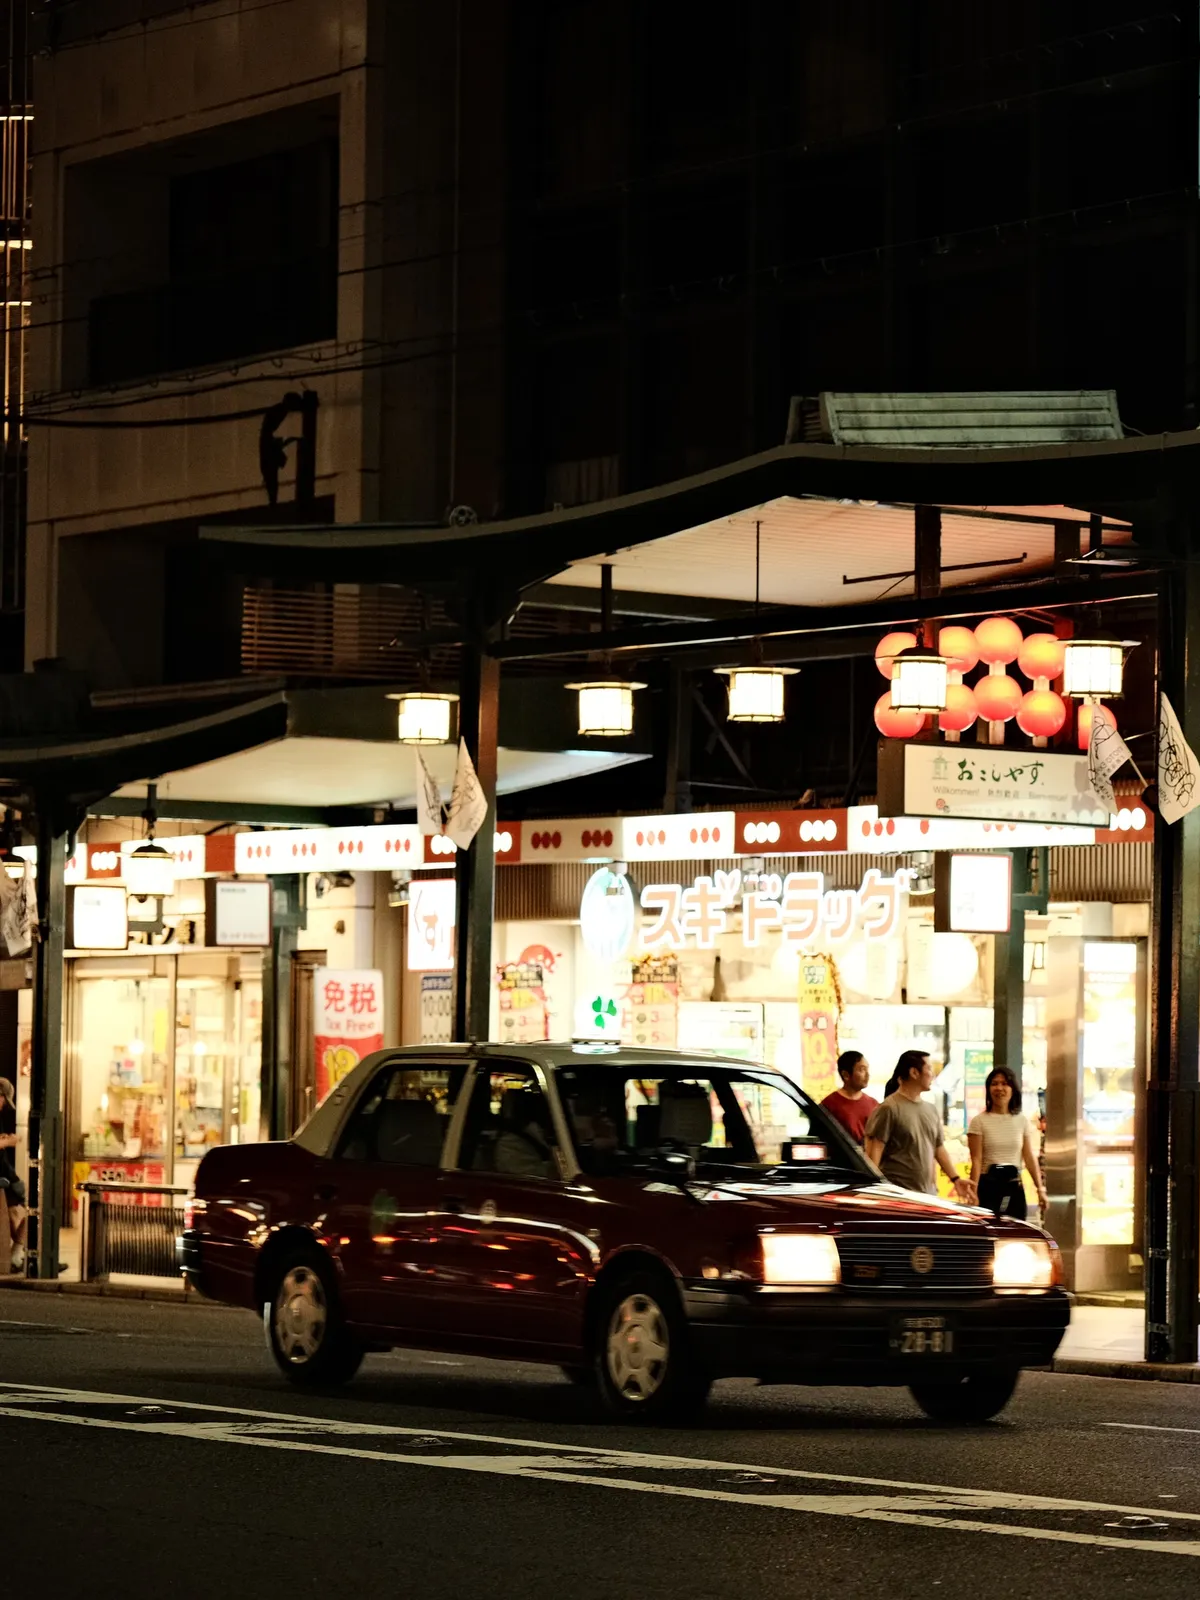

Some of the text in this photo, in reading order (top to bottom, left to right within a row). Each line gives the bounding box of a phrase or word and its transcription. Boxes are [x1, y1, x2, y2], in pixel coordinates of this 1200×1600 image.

[957, 758, 1044, 786] おこしやす
[932, 785, 980, 798] Willkommen!
[323, 979, 378, 1015] 免税
[346, 1019, 375, 1032] Free
